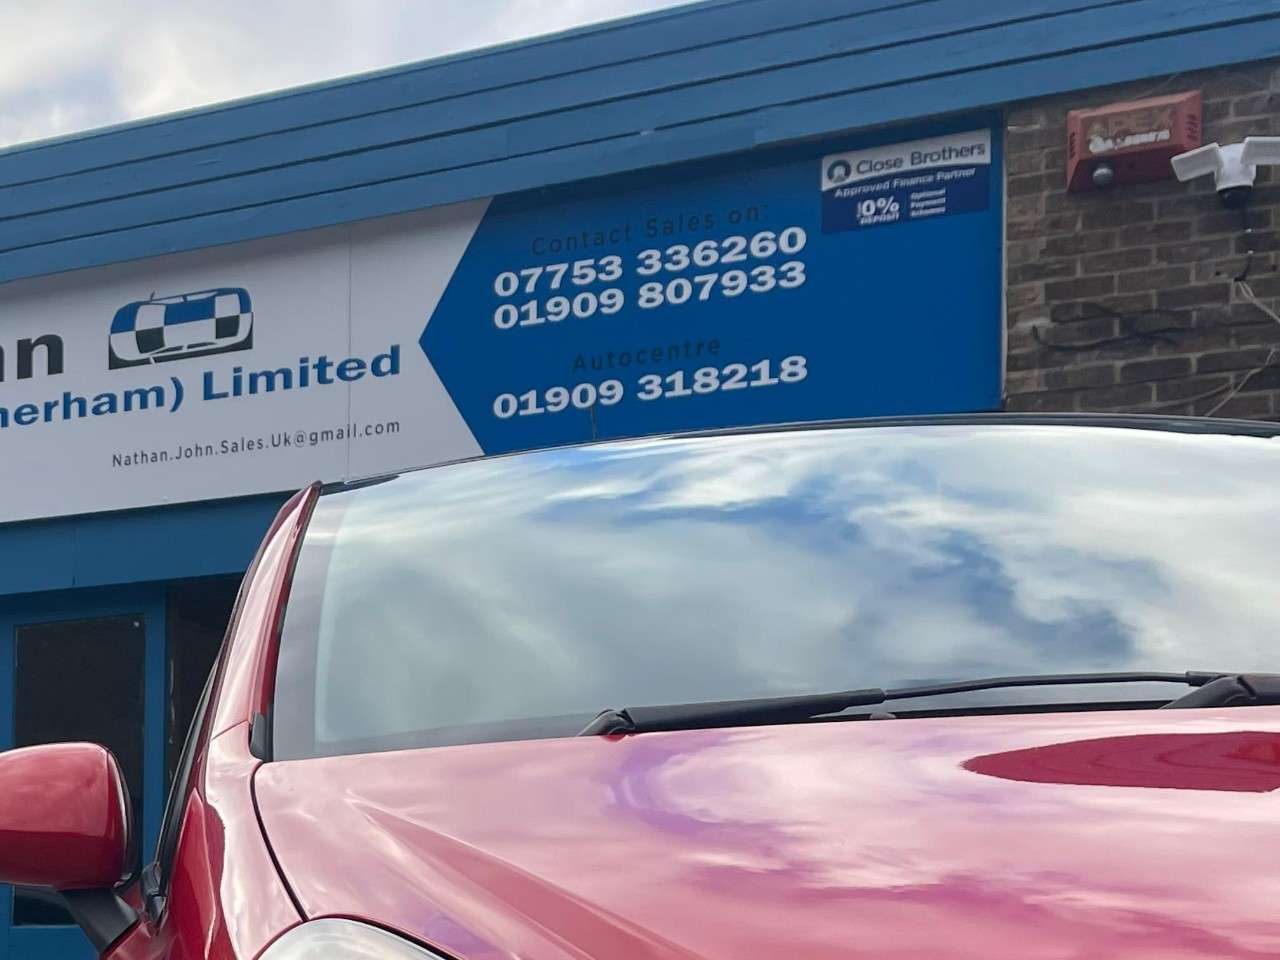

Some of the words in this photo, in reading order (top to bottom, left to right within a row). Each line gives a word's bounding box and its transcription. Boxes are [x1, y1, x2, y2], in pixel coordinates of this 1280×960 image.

[834, 180, 890, 198] Approved
[892, 174, 934, 188] Finance
[936, 168, 976, 181] Partner
[856, 157, 904, 175] Close
[910, 142, 985, 166] Brothers
[531, 222, 633, 256] Contact
[644, 211, 716, 238] Sales
[493, 254, 623, 298] 07753
[636, 226, 808, 276] 336260
[493, 288, 625, 330] 01909
[637, 260, 807, 310] 807933
[202, 344, 401, 400] Limited
[571, 338, 722, 375] Autocentre
[492, 378, 625, 419] 01909
[636, 355, 808, 402] 318218
[112, 419, 401, 468] Nathan.John.Sales.Uk@gmail.com
